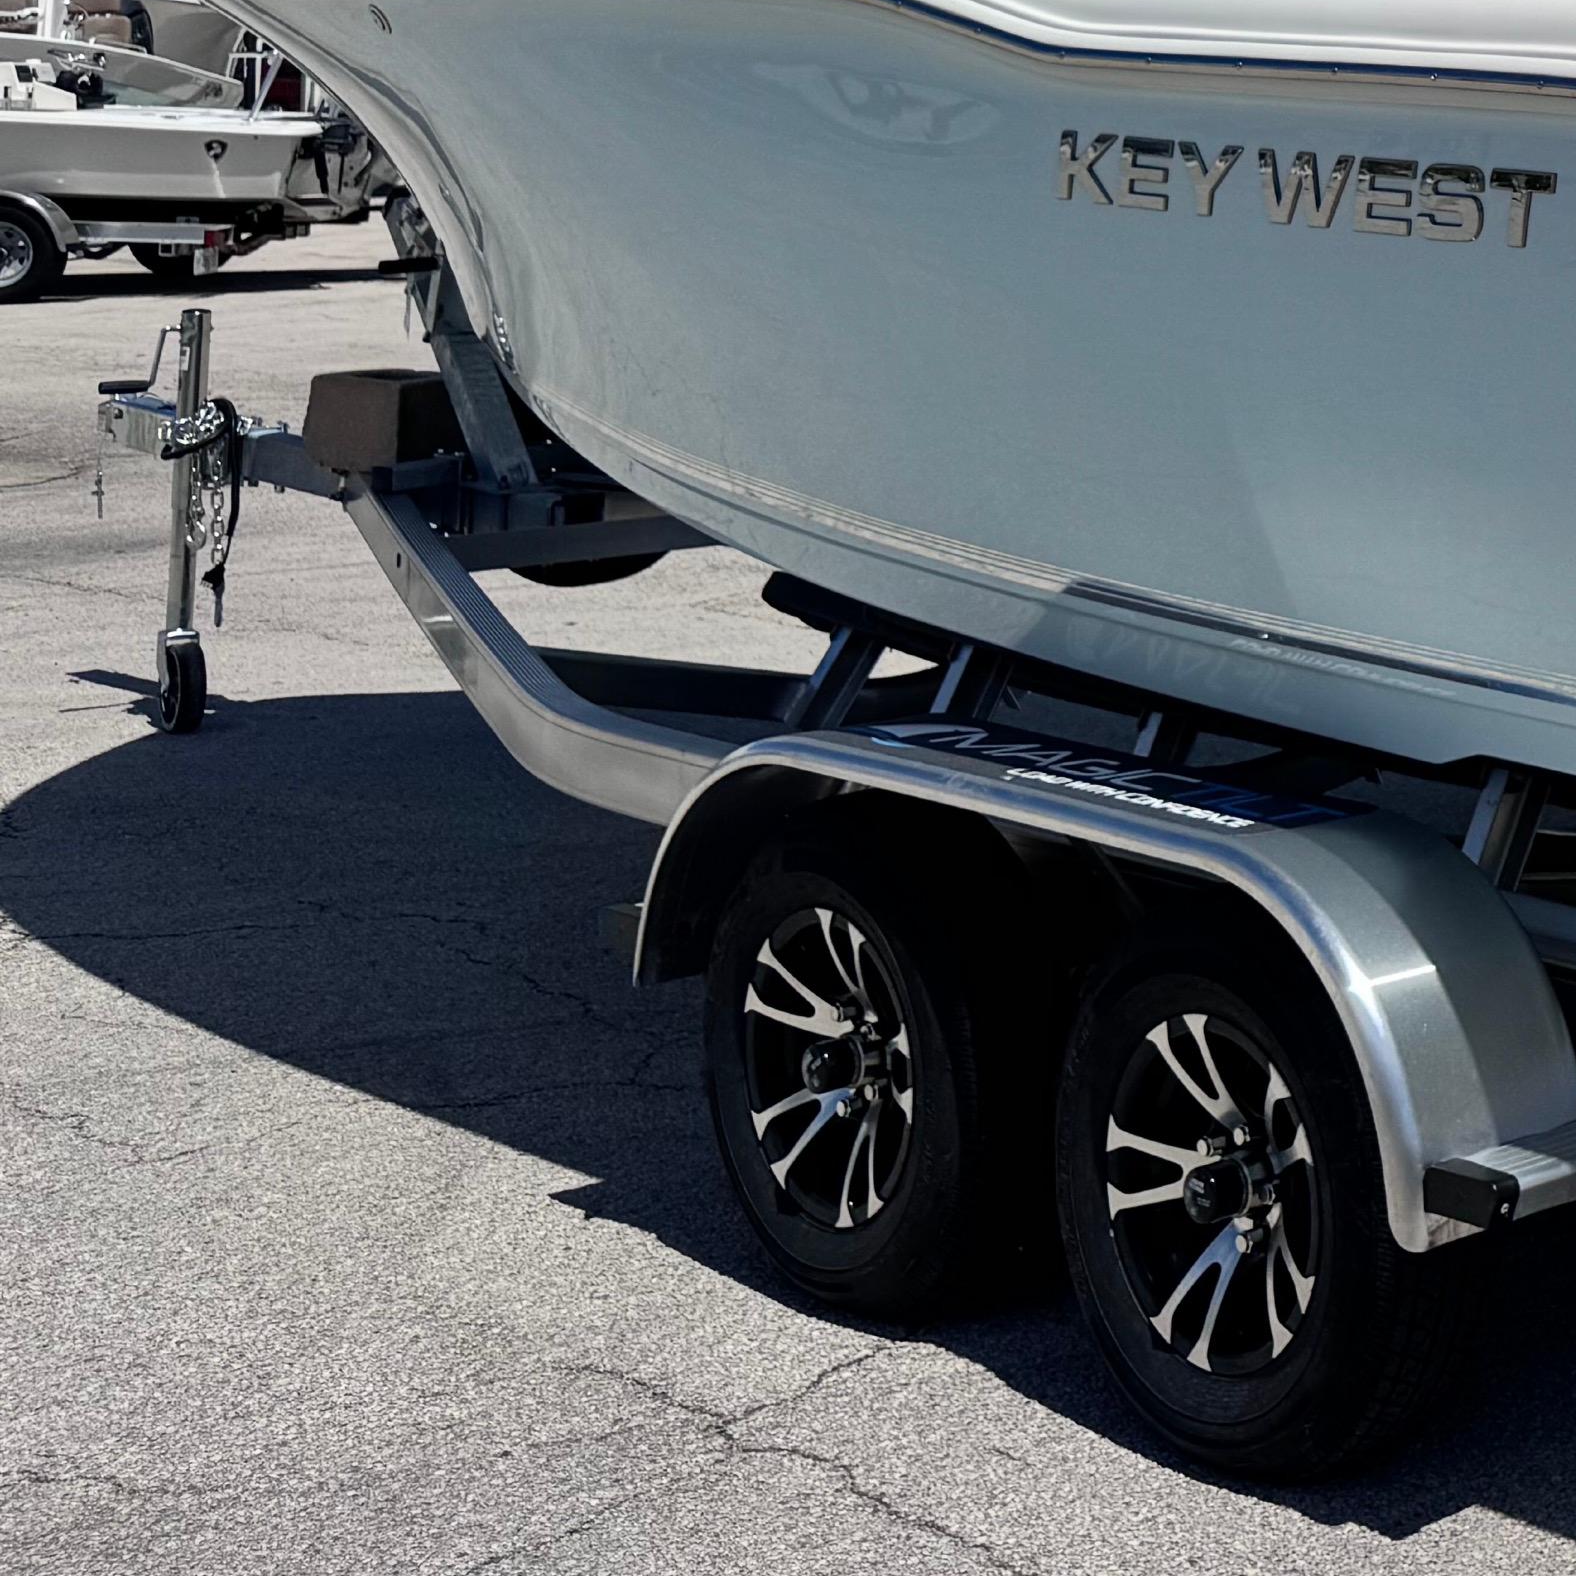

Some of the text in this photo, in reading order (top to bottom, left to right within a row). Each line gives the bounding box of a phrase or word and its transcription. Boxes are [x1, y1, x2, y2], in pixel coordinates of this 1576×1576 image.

[1056, 128, 1558, 249] KEY WEST
[928, 729, 1202, 792] MAGIC
[1006, 767, 1256, 828] LOAD WITH CONFIDENCE
